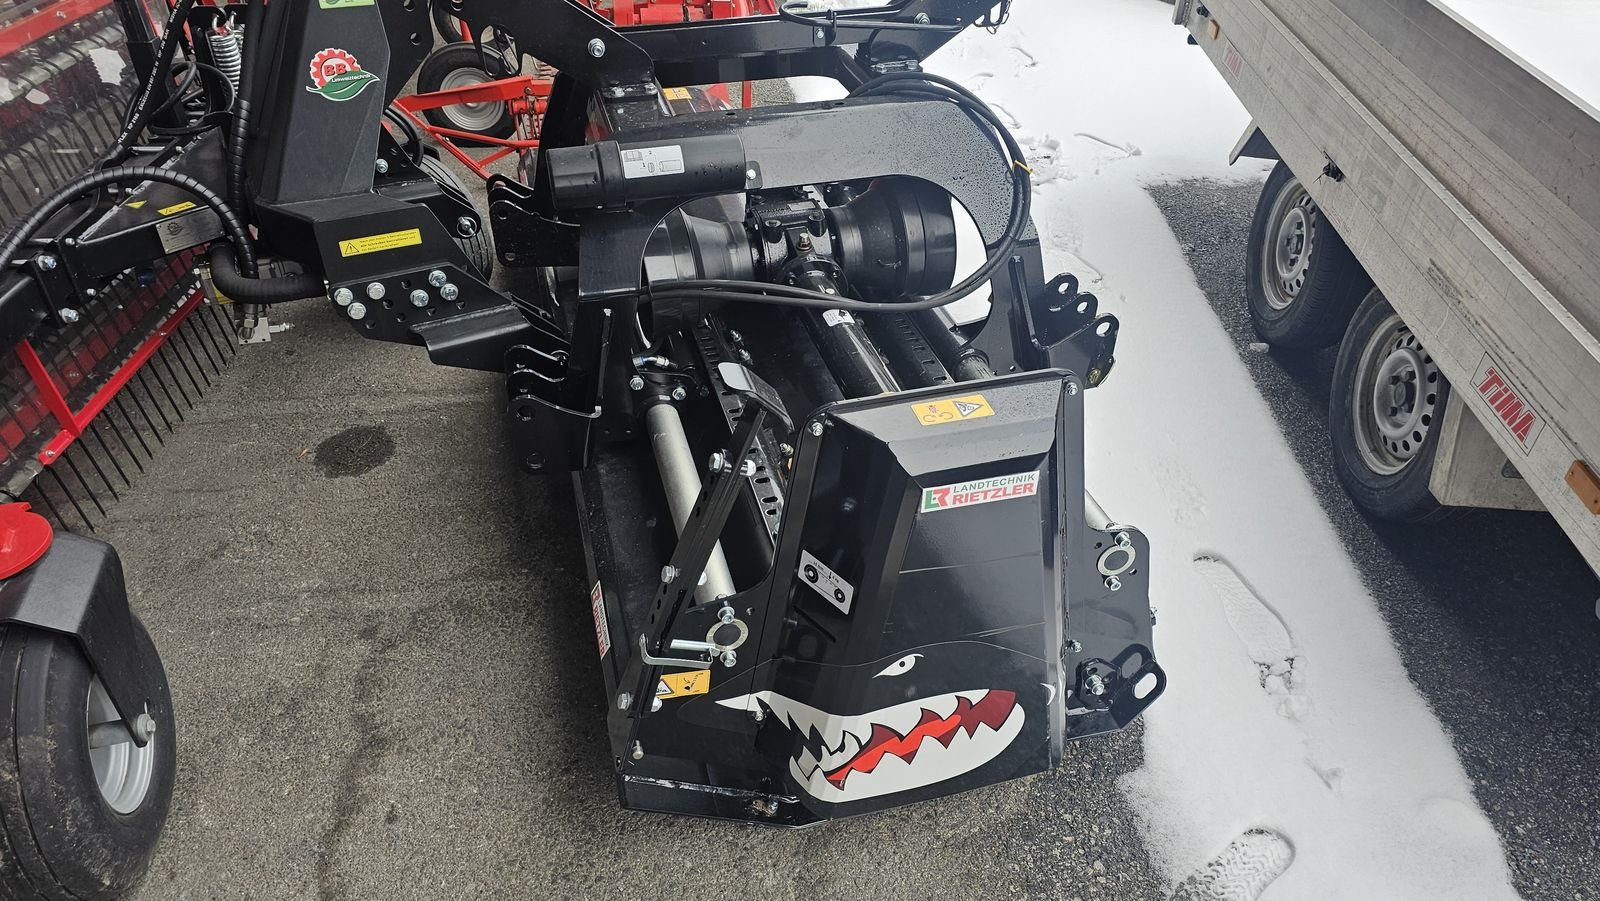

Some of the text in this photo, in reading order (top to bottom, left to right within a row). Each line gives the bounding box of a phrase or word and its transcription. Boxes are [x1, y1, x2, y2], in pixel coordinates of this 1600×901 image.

[323, 63, 347, 77] BB
[952, 482, 1034, 505] RIETZLER
[953, 473, 1035, 494] LANDTECHNIK
